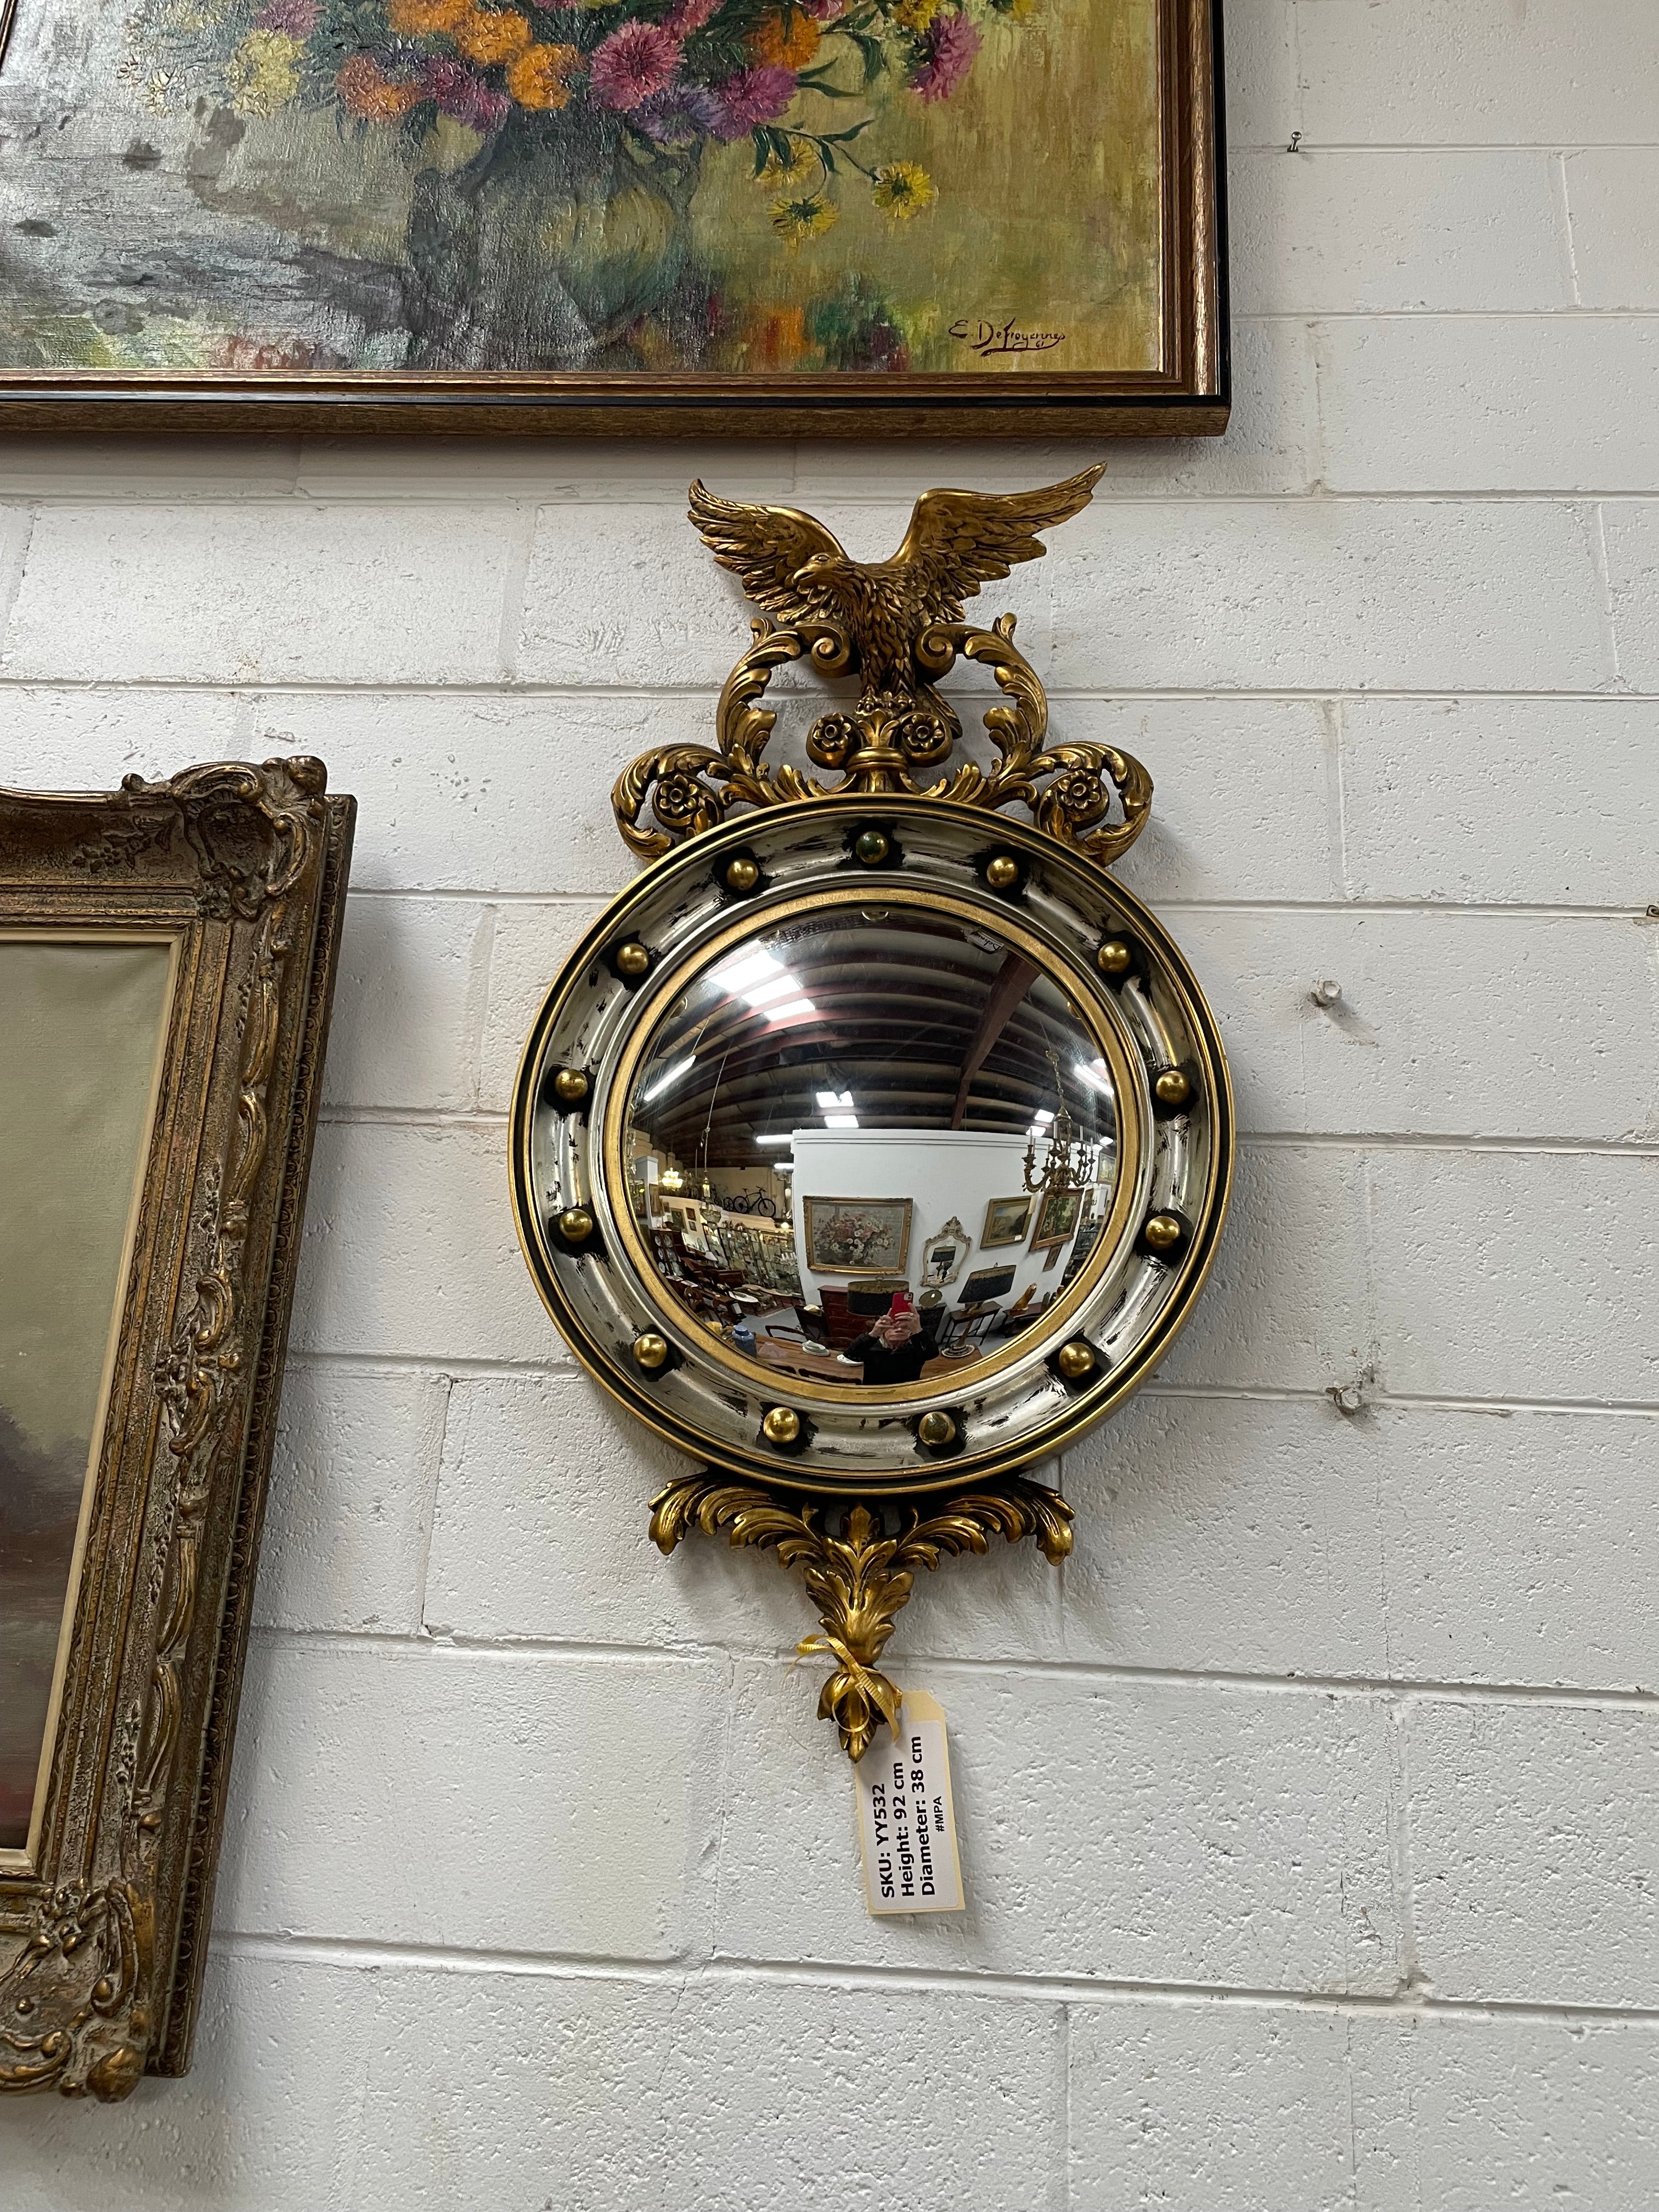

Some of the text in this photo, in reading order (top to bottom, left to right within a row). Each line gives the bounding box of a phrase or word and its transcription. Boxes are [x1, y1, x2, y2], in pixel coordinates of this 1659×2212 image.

[872, 1783, 895, 1898] SKU: YY532
[893, 1763, 915, 1897] Height: 92 cm
[911, 1736, 935, 1895] Diameter: 38 cm
[933, 1796, 945, 1832] #MPA
